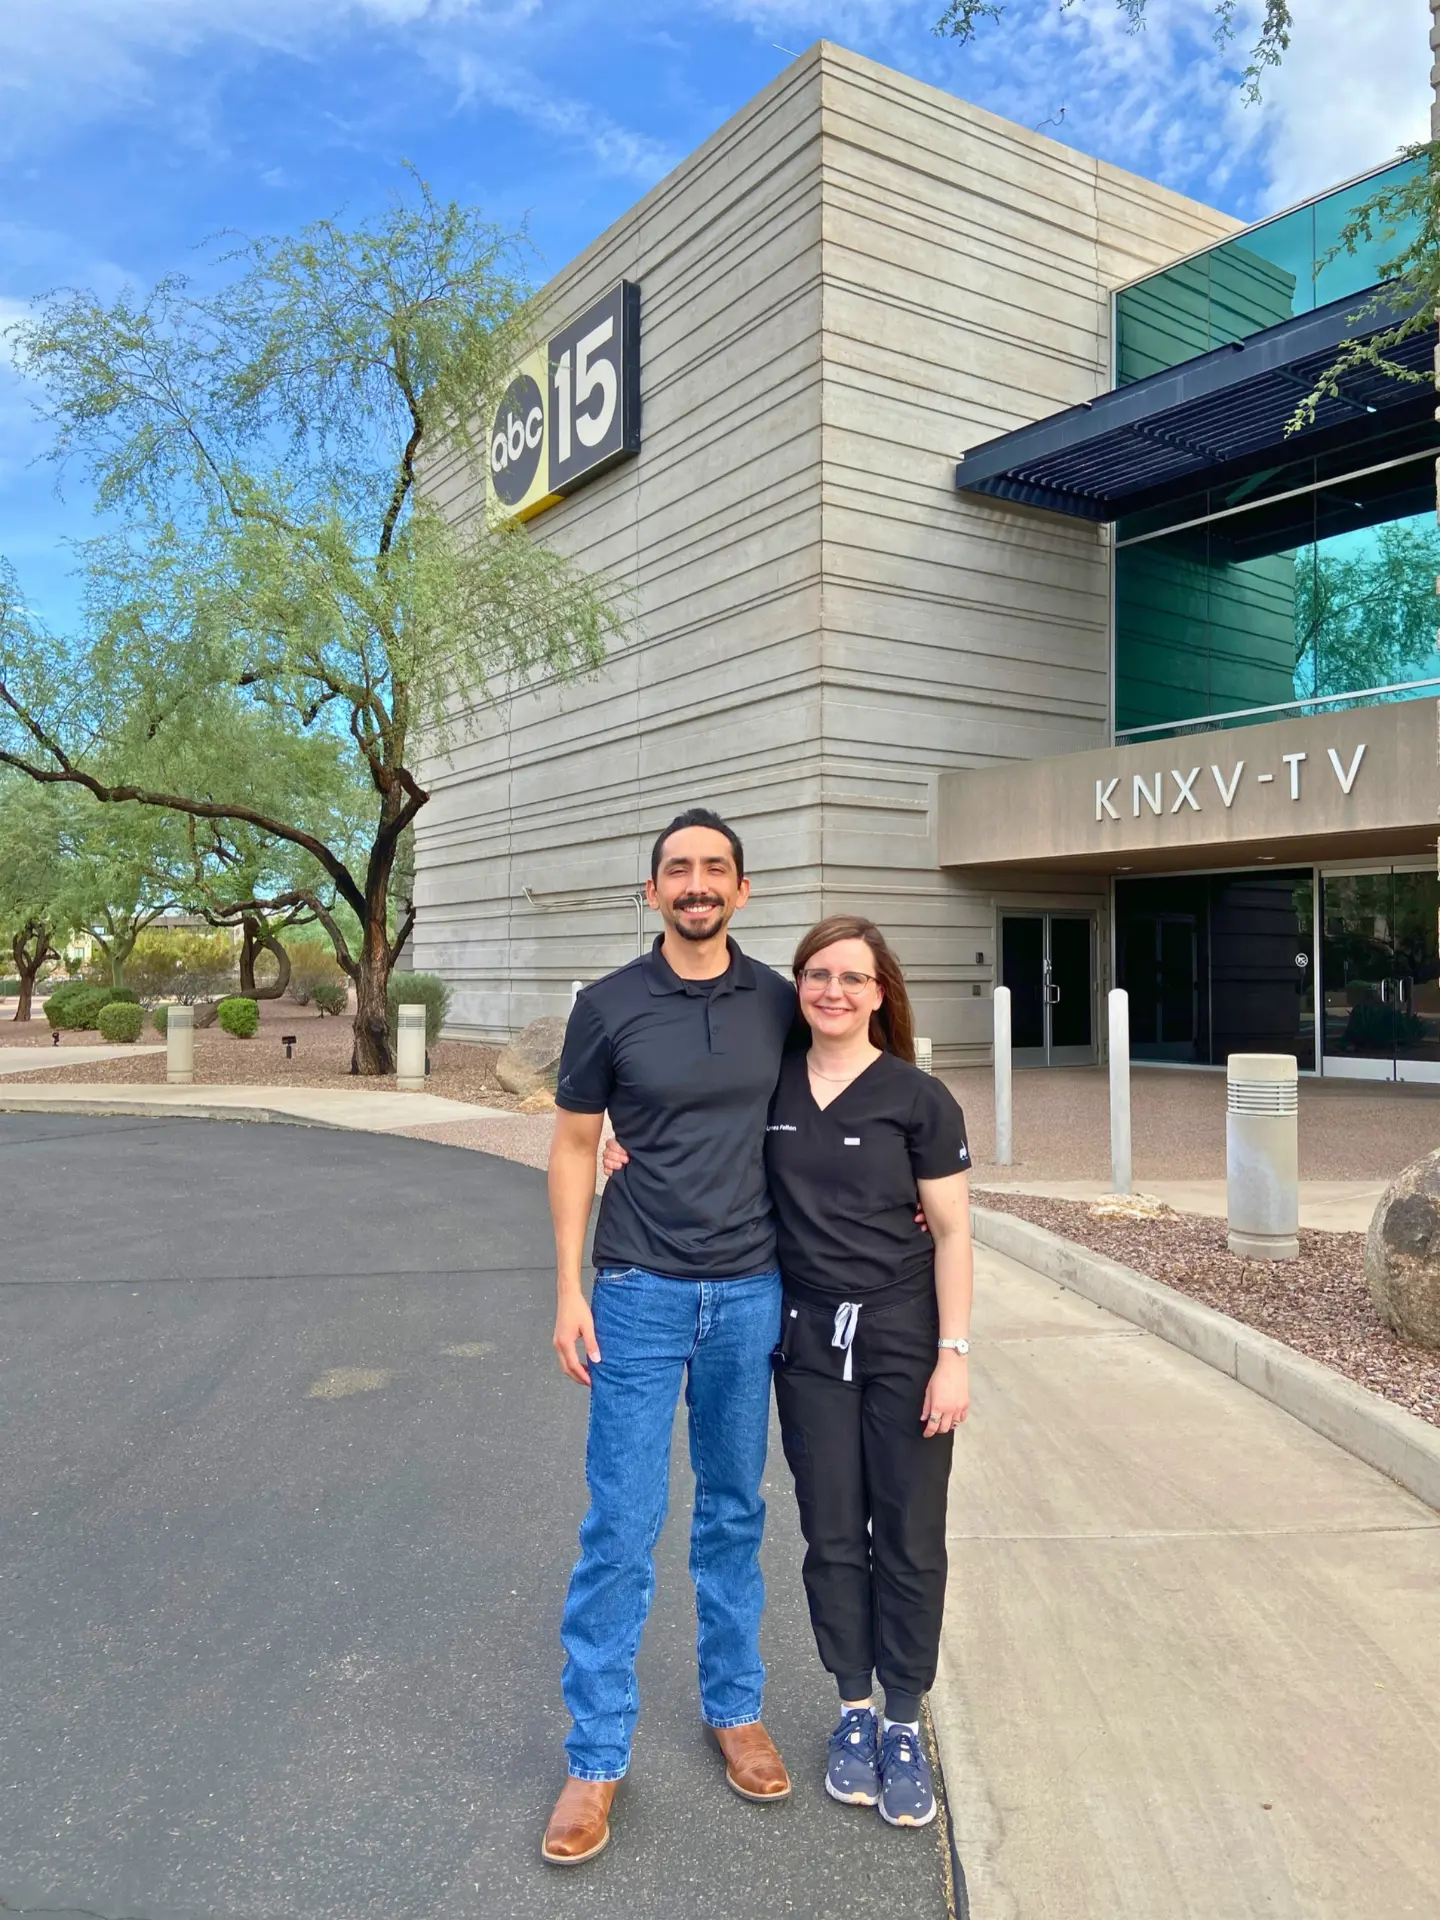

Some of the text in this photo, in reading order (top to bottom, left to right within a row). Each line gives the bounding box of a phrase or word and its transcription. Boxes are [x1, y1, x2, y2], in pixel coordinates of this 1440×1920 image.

[492, 315, 617, 473] abc 15
[1095, 744, 1368, 821] KNXV-TV
